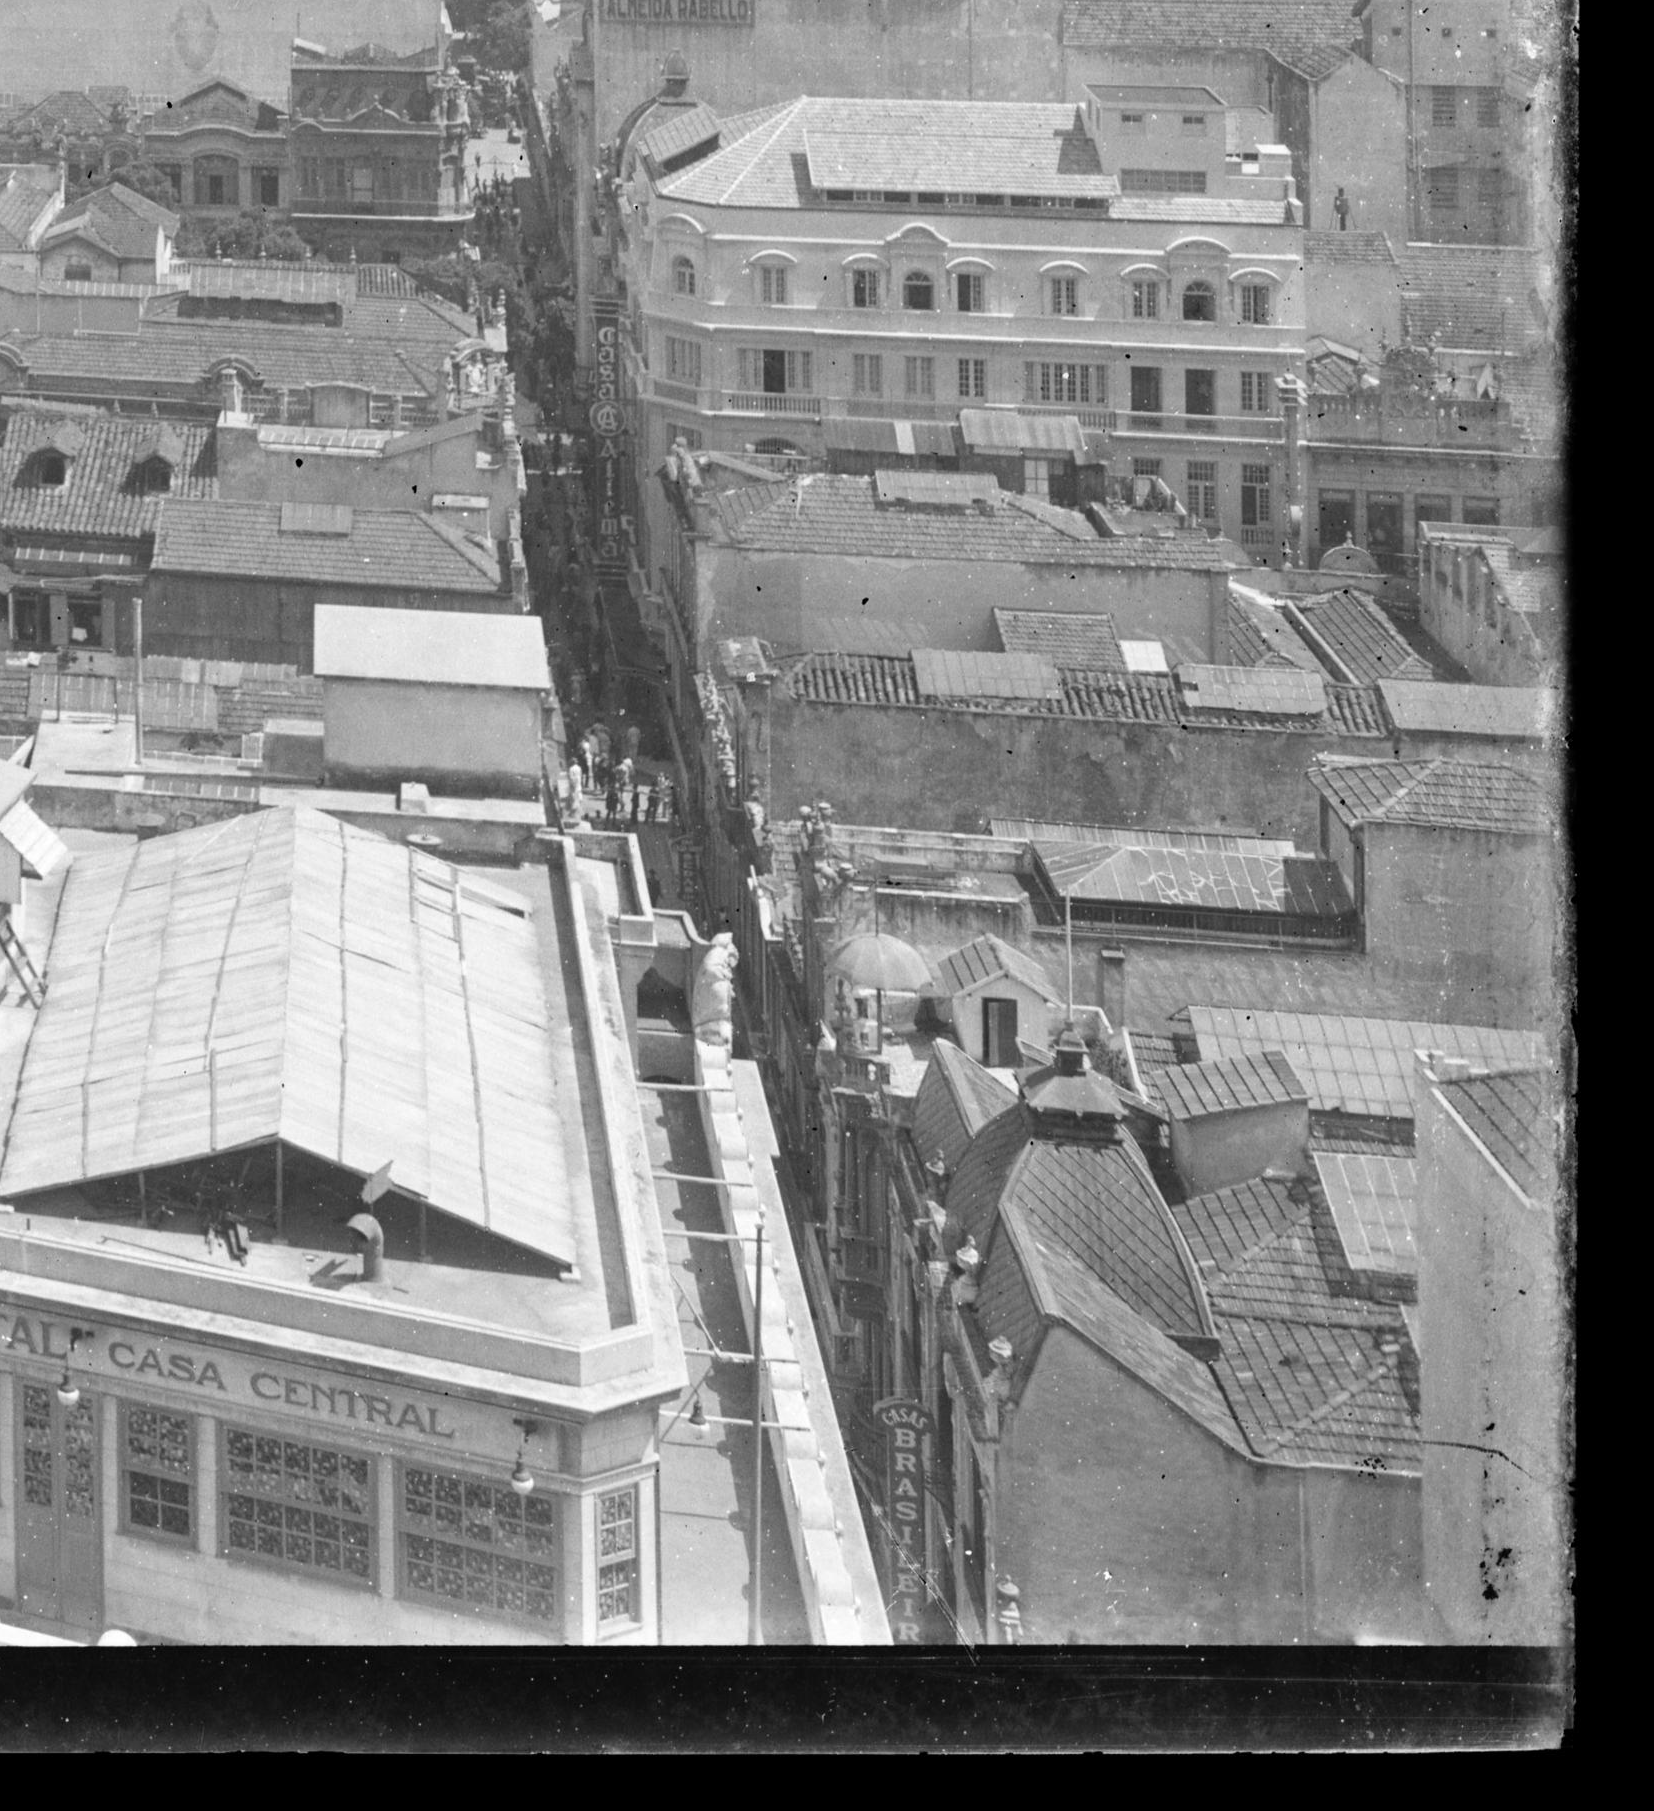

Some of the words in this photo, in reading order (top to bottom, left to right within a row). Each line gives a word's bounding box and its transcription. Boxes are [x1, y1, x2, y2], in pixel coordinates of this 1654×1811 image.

[108, 1341, 228, 1391] CASA
[250, 1372, 456, 1438] CENTRAL
[881, 1407, 929, 1429] CASAS
